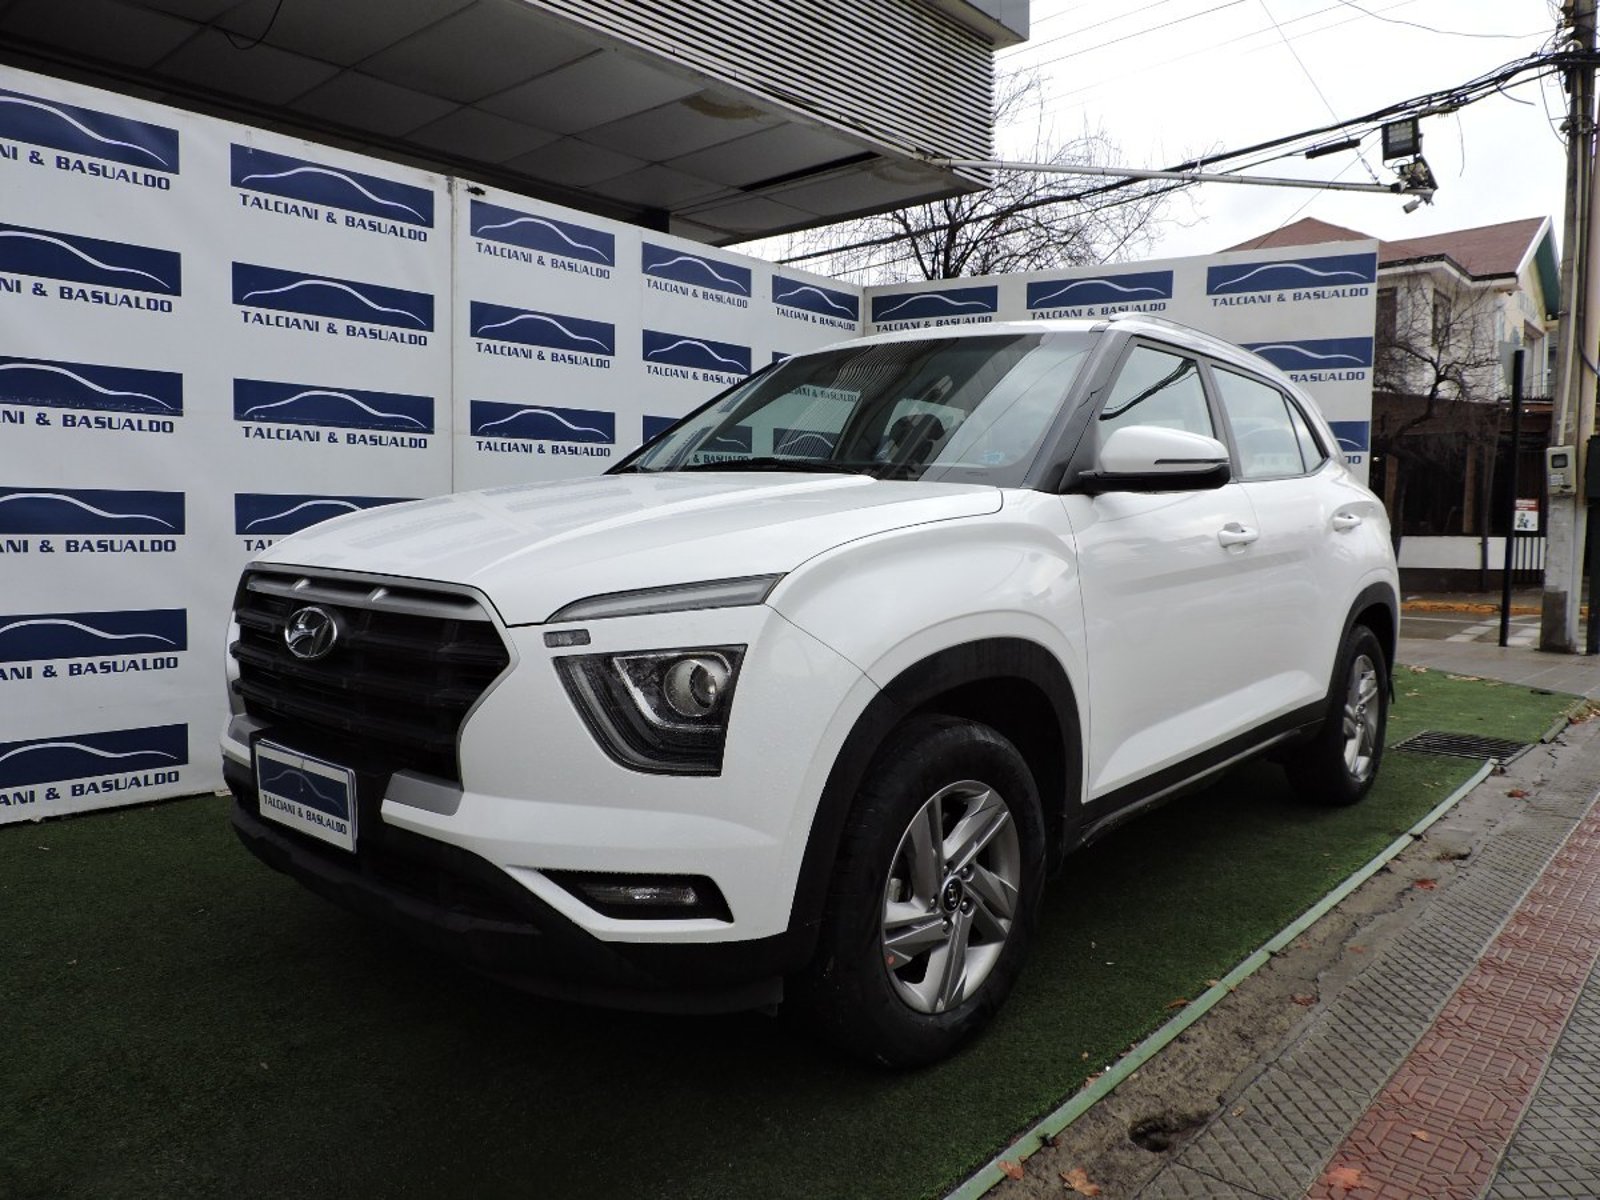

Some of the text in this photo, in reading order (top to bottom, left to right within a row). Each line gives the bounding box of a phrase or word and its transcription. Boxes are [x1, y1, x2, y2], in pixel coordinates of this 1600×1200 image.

[29, 151, 44, 165] &
[56, 156, 170, 190] BASUALDO
[240, 193, 427, 242] TALCIANI & BASUALDO
[476, 242, 610, 279] TALCIANI & BASUALDO
[32, 283, 48, 296] &
[60, 286, 172, 312] BASUALDO
[647, 278, 747, 308] TALCIANI & BASUALDO
[1212, 288, 1368, 306] TALCIANI & BASUALDO
[776, 307, 808, 322] TALCIANI
[820, 317, 855, 331] BASUALDO
[1032, 302, 1166, 320] TALCIANI & BASUALDO
[241, 311, 427, 346] TALCIANI & BASUALDO
[476, 342, 610, 368] TALCIANI & BASUALDO
[647, 365, 688, 379] TALCIANI
[692, 372, 699, 380] &
[1290, 372, 1365, 382] BASUALDO
[36, 412, 51, 425] &
[62, 414, 174, 433] BASUALDO
[242, 426, 427, 448] TALCIANI & BASUALDO
[476, 441, 610, 456] TALCIANI & BASUALDO
[40, 540, 54, 552] &
[66, 540, 176, 552] BASUALDO
[43, 665, 58, 678] &
[69, 657, 178, 676] BASUALDO
[46, 788, 60, 800] &
[72, 771, 179, 796] BASUALDO
